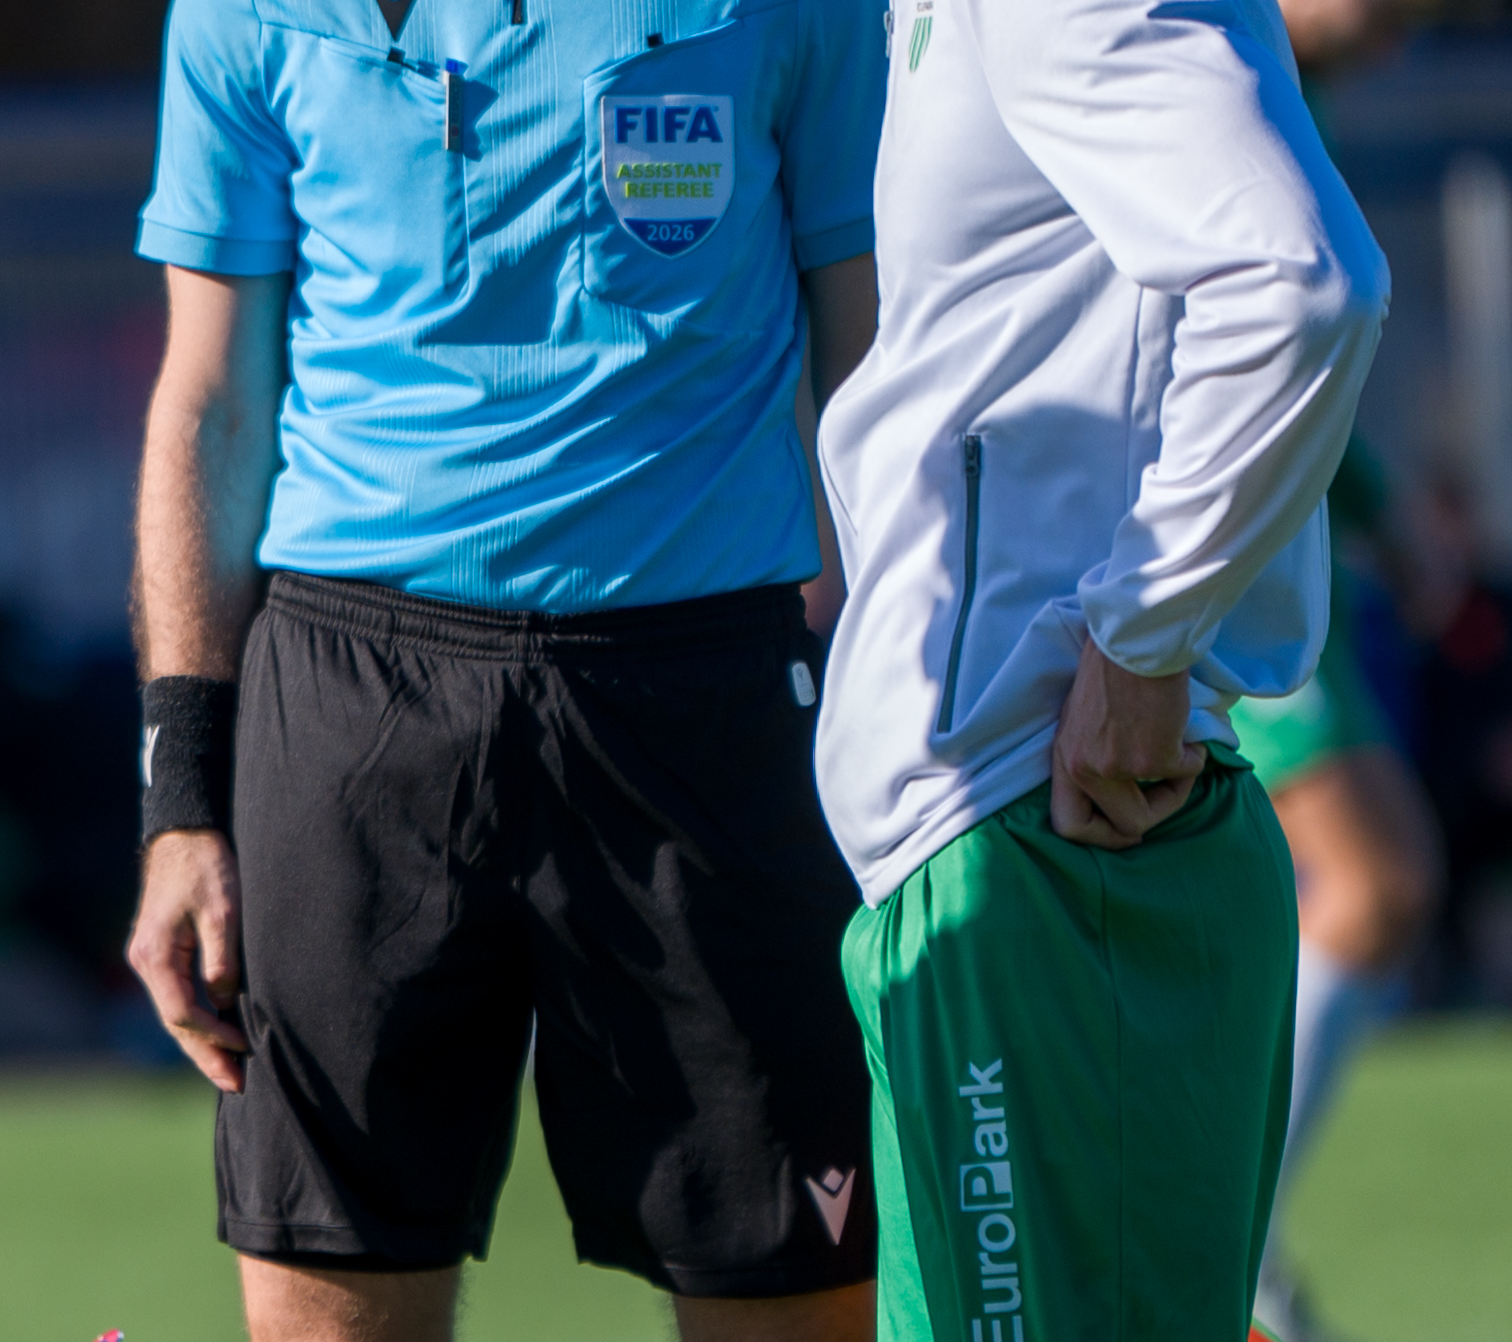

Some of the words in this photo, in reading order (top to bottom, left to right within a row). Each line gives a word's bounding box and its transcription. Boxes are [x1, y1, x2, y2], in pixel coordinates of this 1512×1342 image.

[615, 105, 723, 144] FIFA
[616, 163, 722, 179] ASSISTANT
[624, 181, 714, 198] REFEREE
[647, 224, 694, 241] 2026
